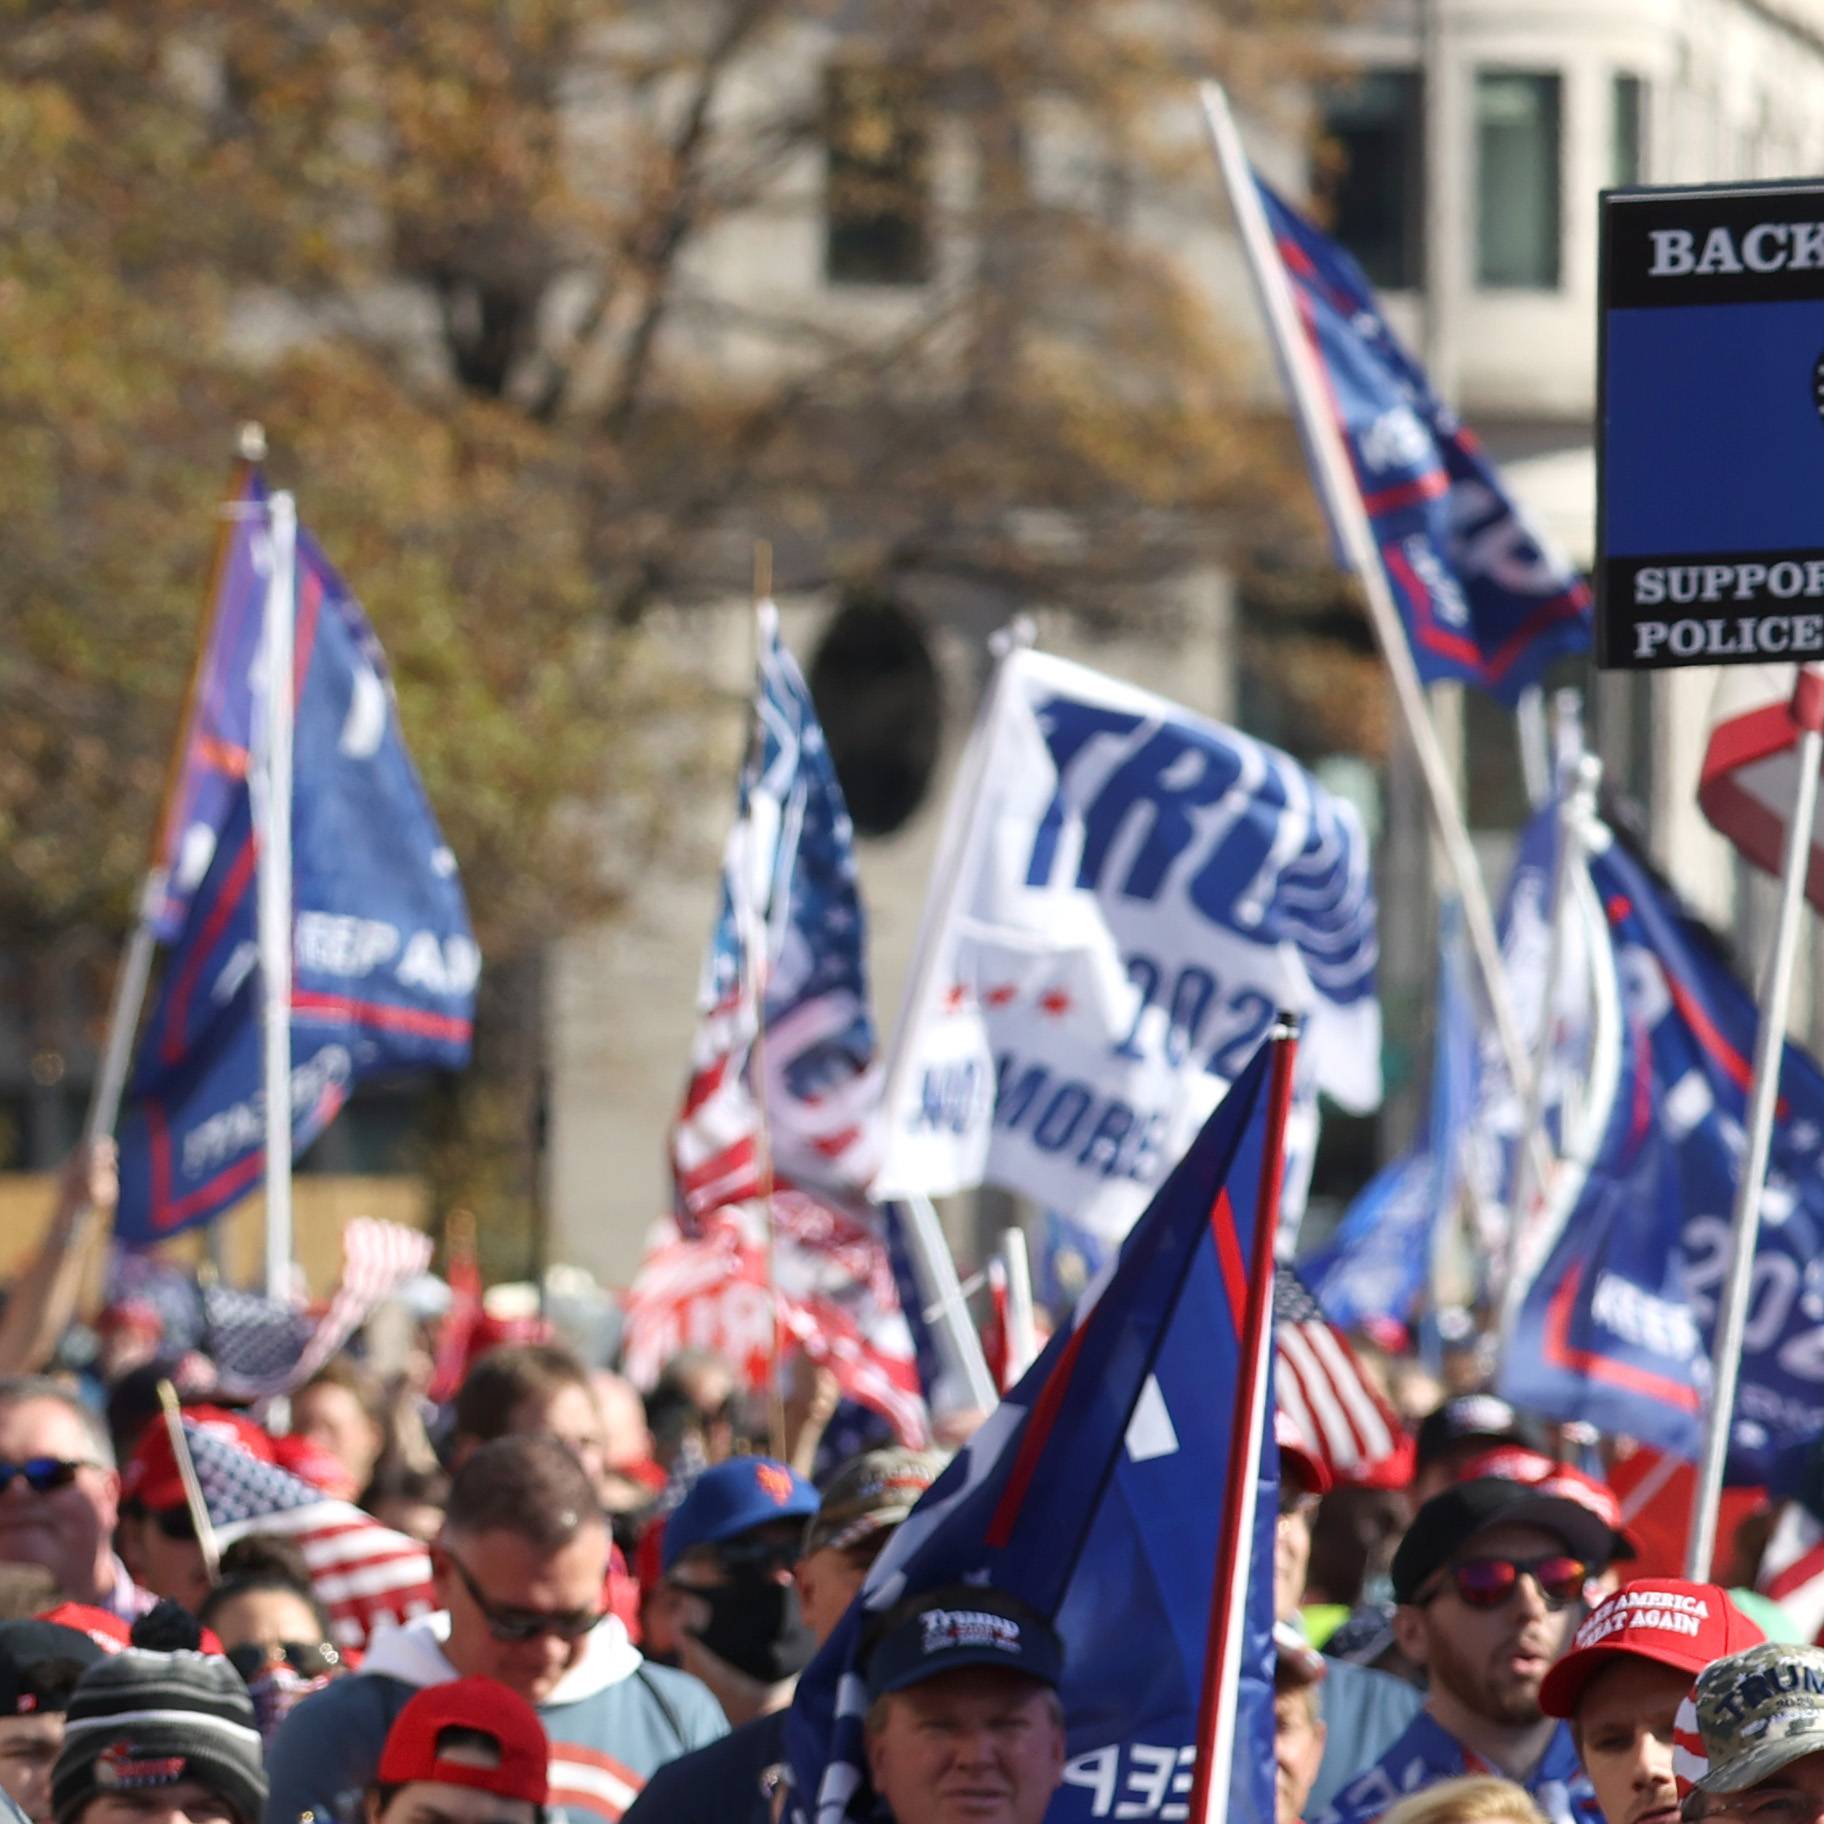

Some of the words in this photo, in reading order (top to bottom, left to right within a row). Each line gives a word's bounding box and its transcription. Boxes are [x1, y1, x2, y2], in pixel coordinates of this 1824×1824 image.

[1649, 222, 1824, 277] BACK
[1634, 614, 1823, 658] POLICE
[1619, 1591, 1710, 1620] AMERICA
[1630, 1609, 1701, 1639] AGAIN
